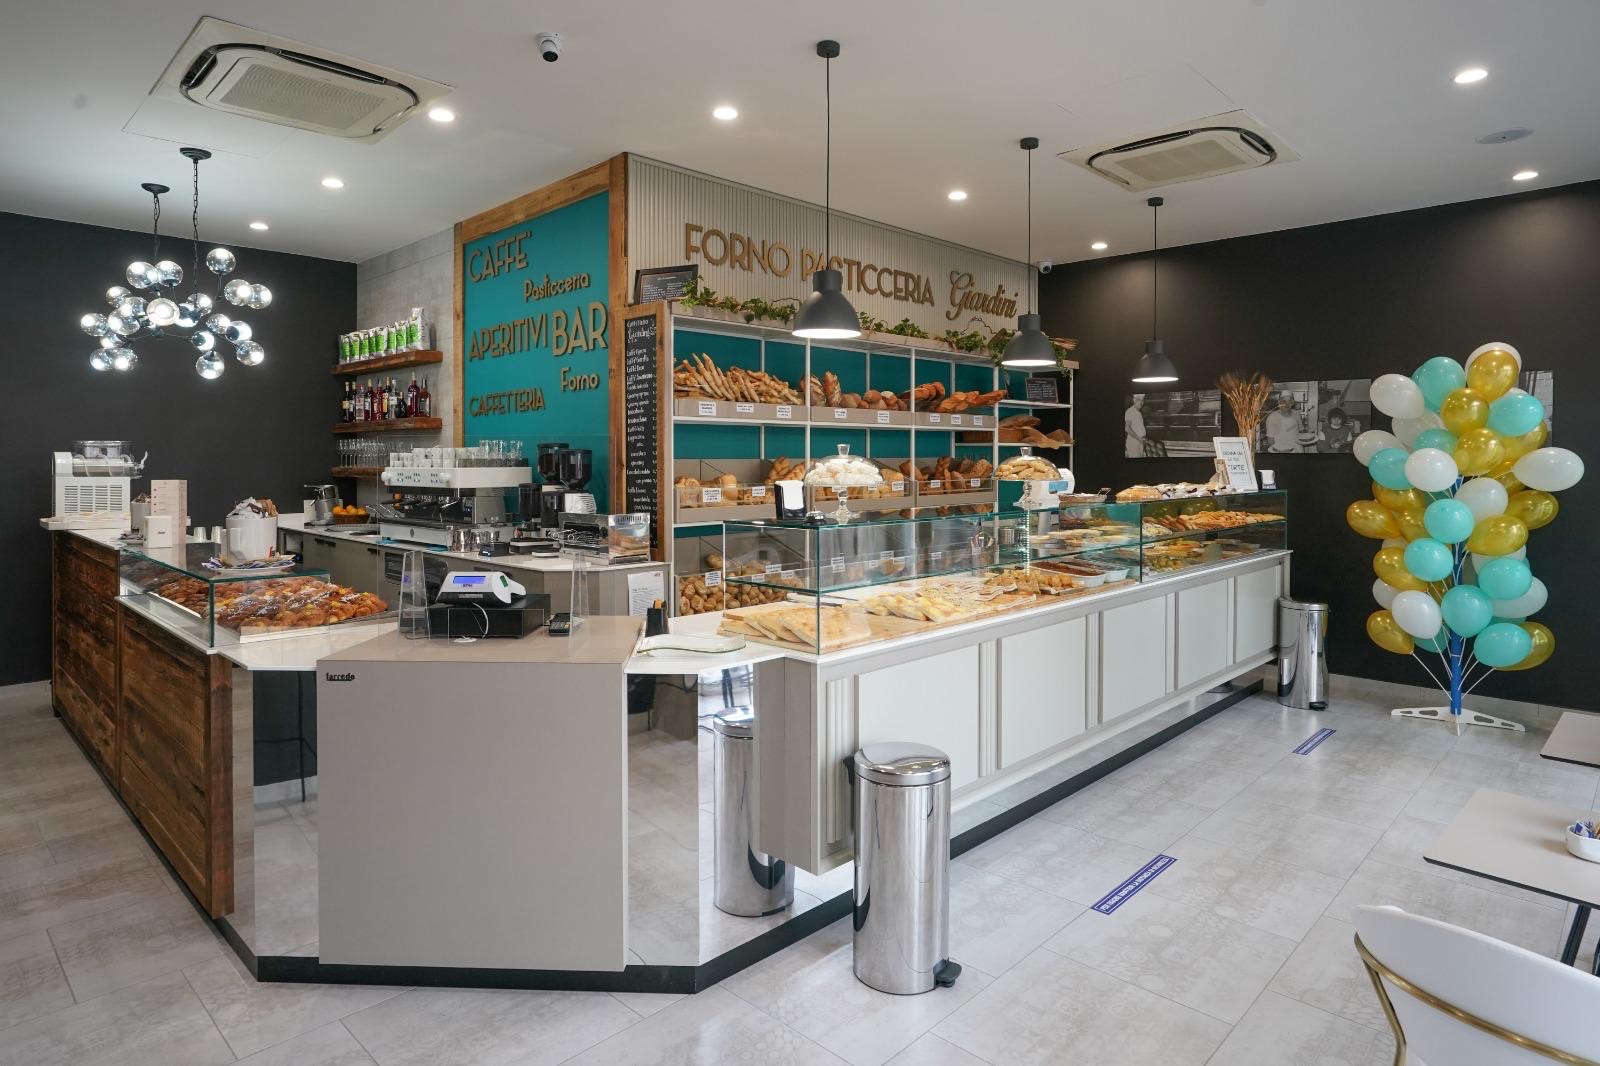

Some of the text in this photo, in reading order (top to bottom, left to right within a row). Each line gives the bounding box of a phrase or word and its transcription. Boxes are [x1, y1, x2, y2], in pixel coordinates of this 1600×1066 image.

[685, 222, 792, 278] FORNO
[945, 270, 1018, 321] Giardini
[523, 272, 591, 303] Pasticceria
[469, 313, 548, 362] APERITIVI
[552, 301, 609, 357] BAR
[560, 367, 600, 393] Forno
[469, 387, 546, 417] CAFFETTERIA
